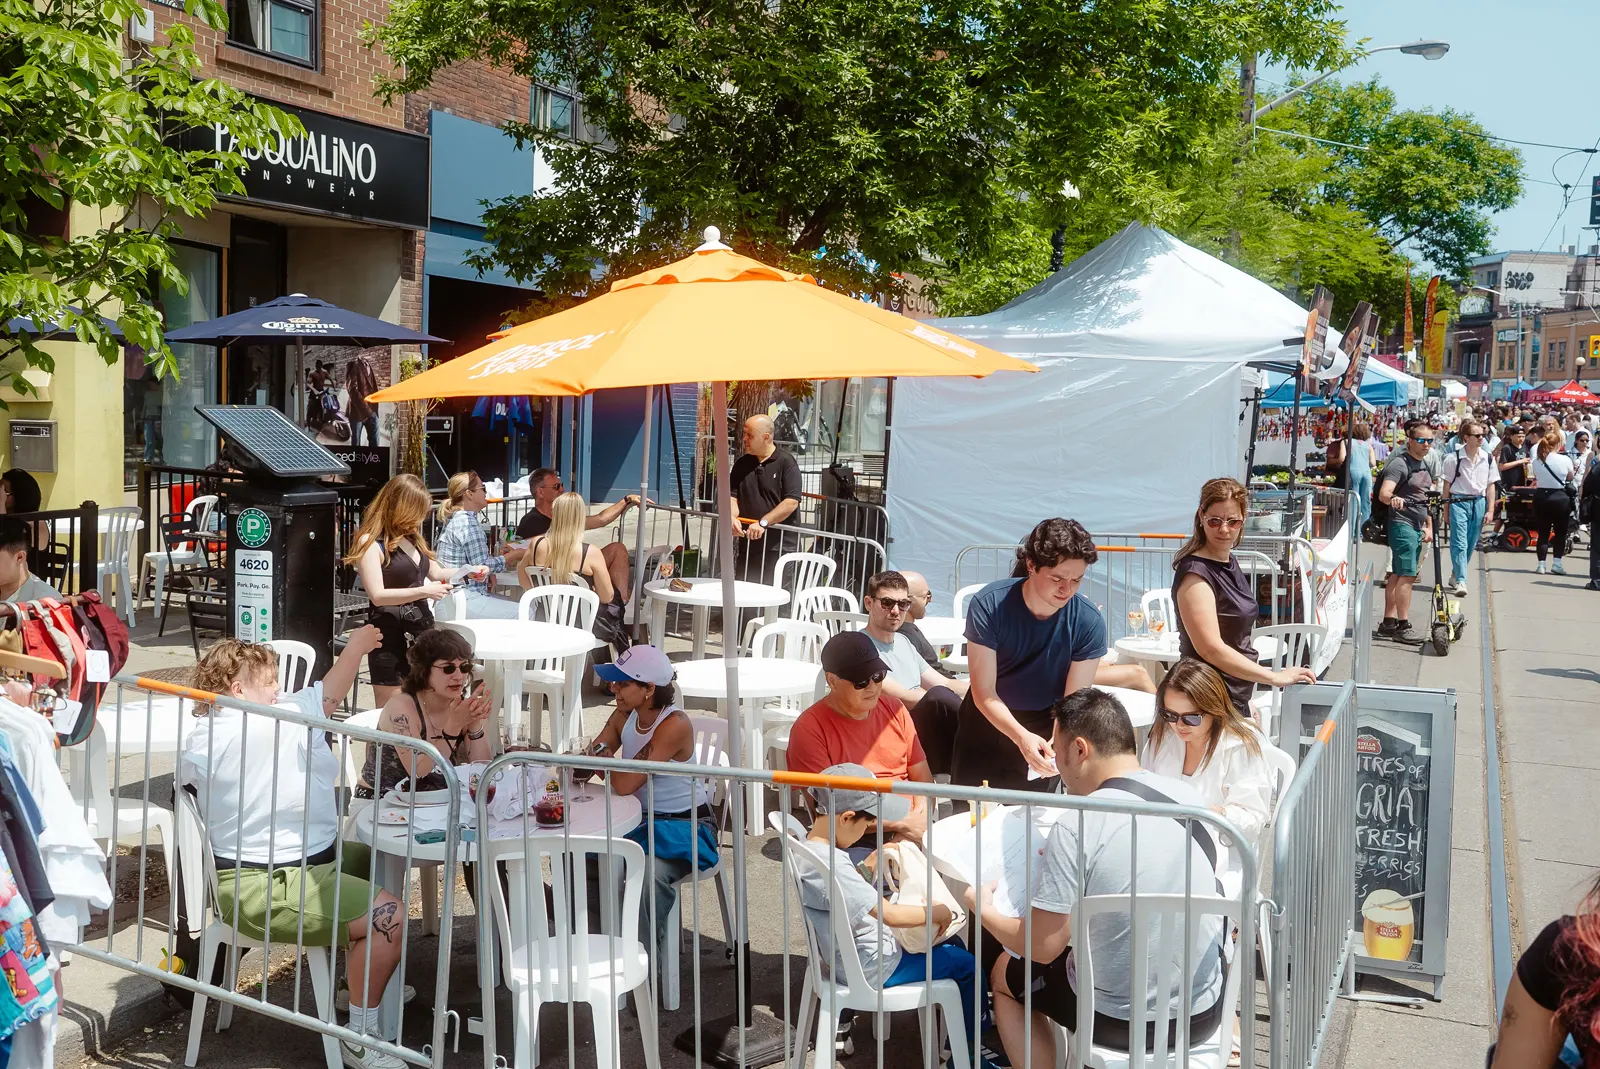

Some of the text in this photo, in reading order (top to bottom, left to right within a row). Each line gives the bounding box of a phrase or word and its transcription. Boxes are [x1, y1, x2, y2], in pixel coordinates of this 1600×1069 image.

[214, 160, 375, 200] MENSWEAR
[261, 321, 344, 330] Corona
[247, 518, 261, 534] P
[240, 558, 269, 571] 4620
[1356, 754, 1406, 778] ITRES
[1355, 782, 1416, 826] GRIA
[1355, 825, 1422, 853] FRESH
[1367, 855, 1421, 875] ERRIES
